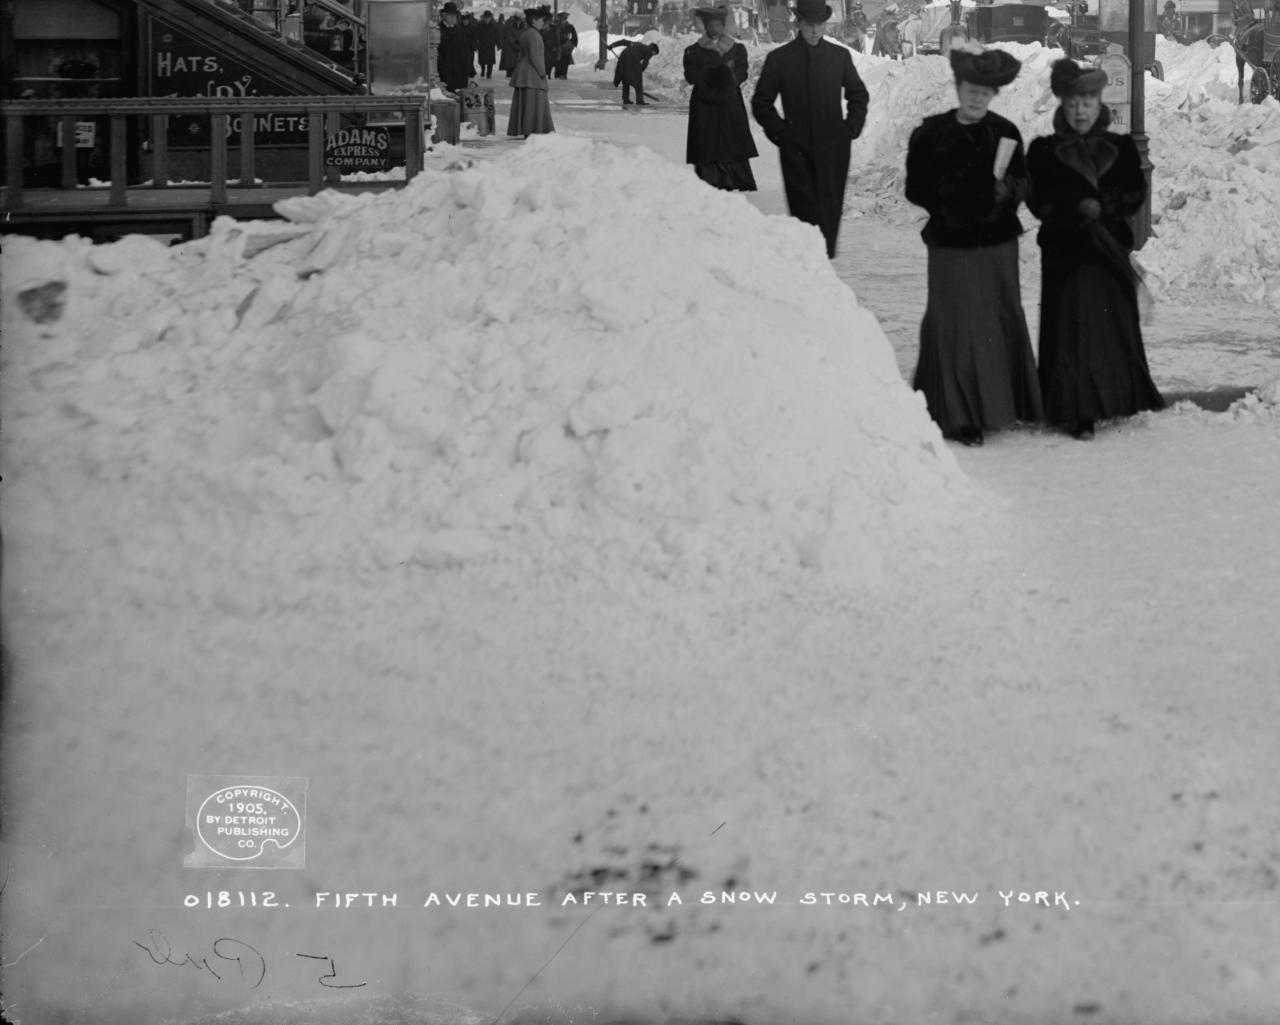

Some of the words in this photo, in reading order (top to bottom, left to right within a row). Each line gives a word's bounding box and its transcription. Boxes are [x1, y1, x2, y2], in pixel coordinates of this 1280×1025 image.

[157, 52, 224, 77] HATS,
[325, 128, 388, 152] ADAMS
[334, 145, 380, 156] EXPRESS
[326, 157, 387, 166] COMPANY
